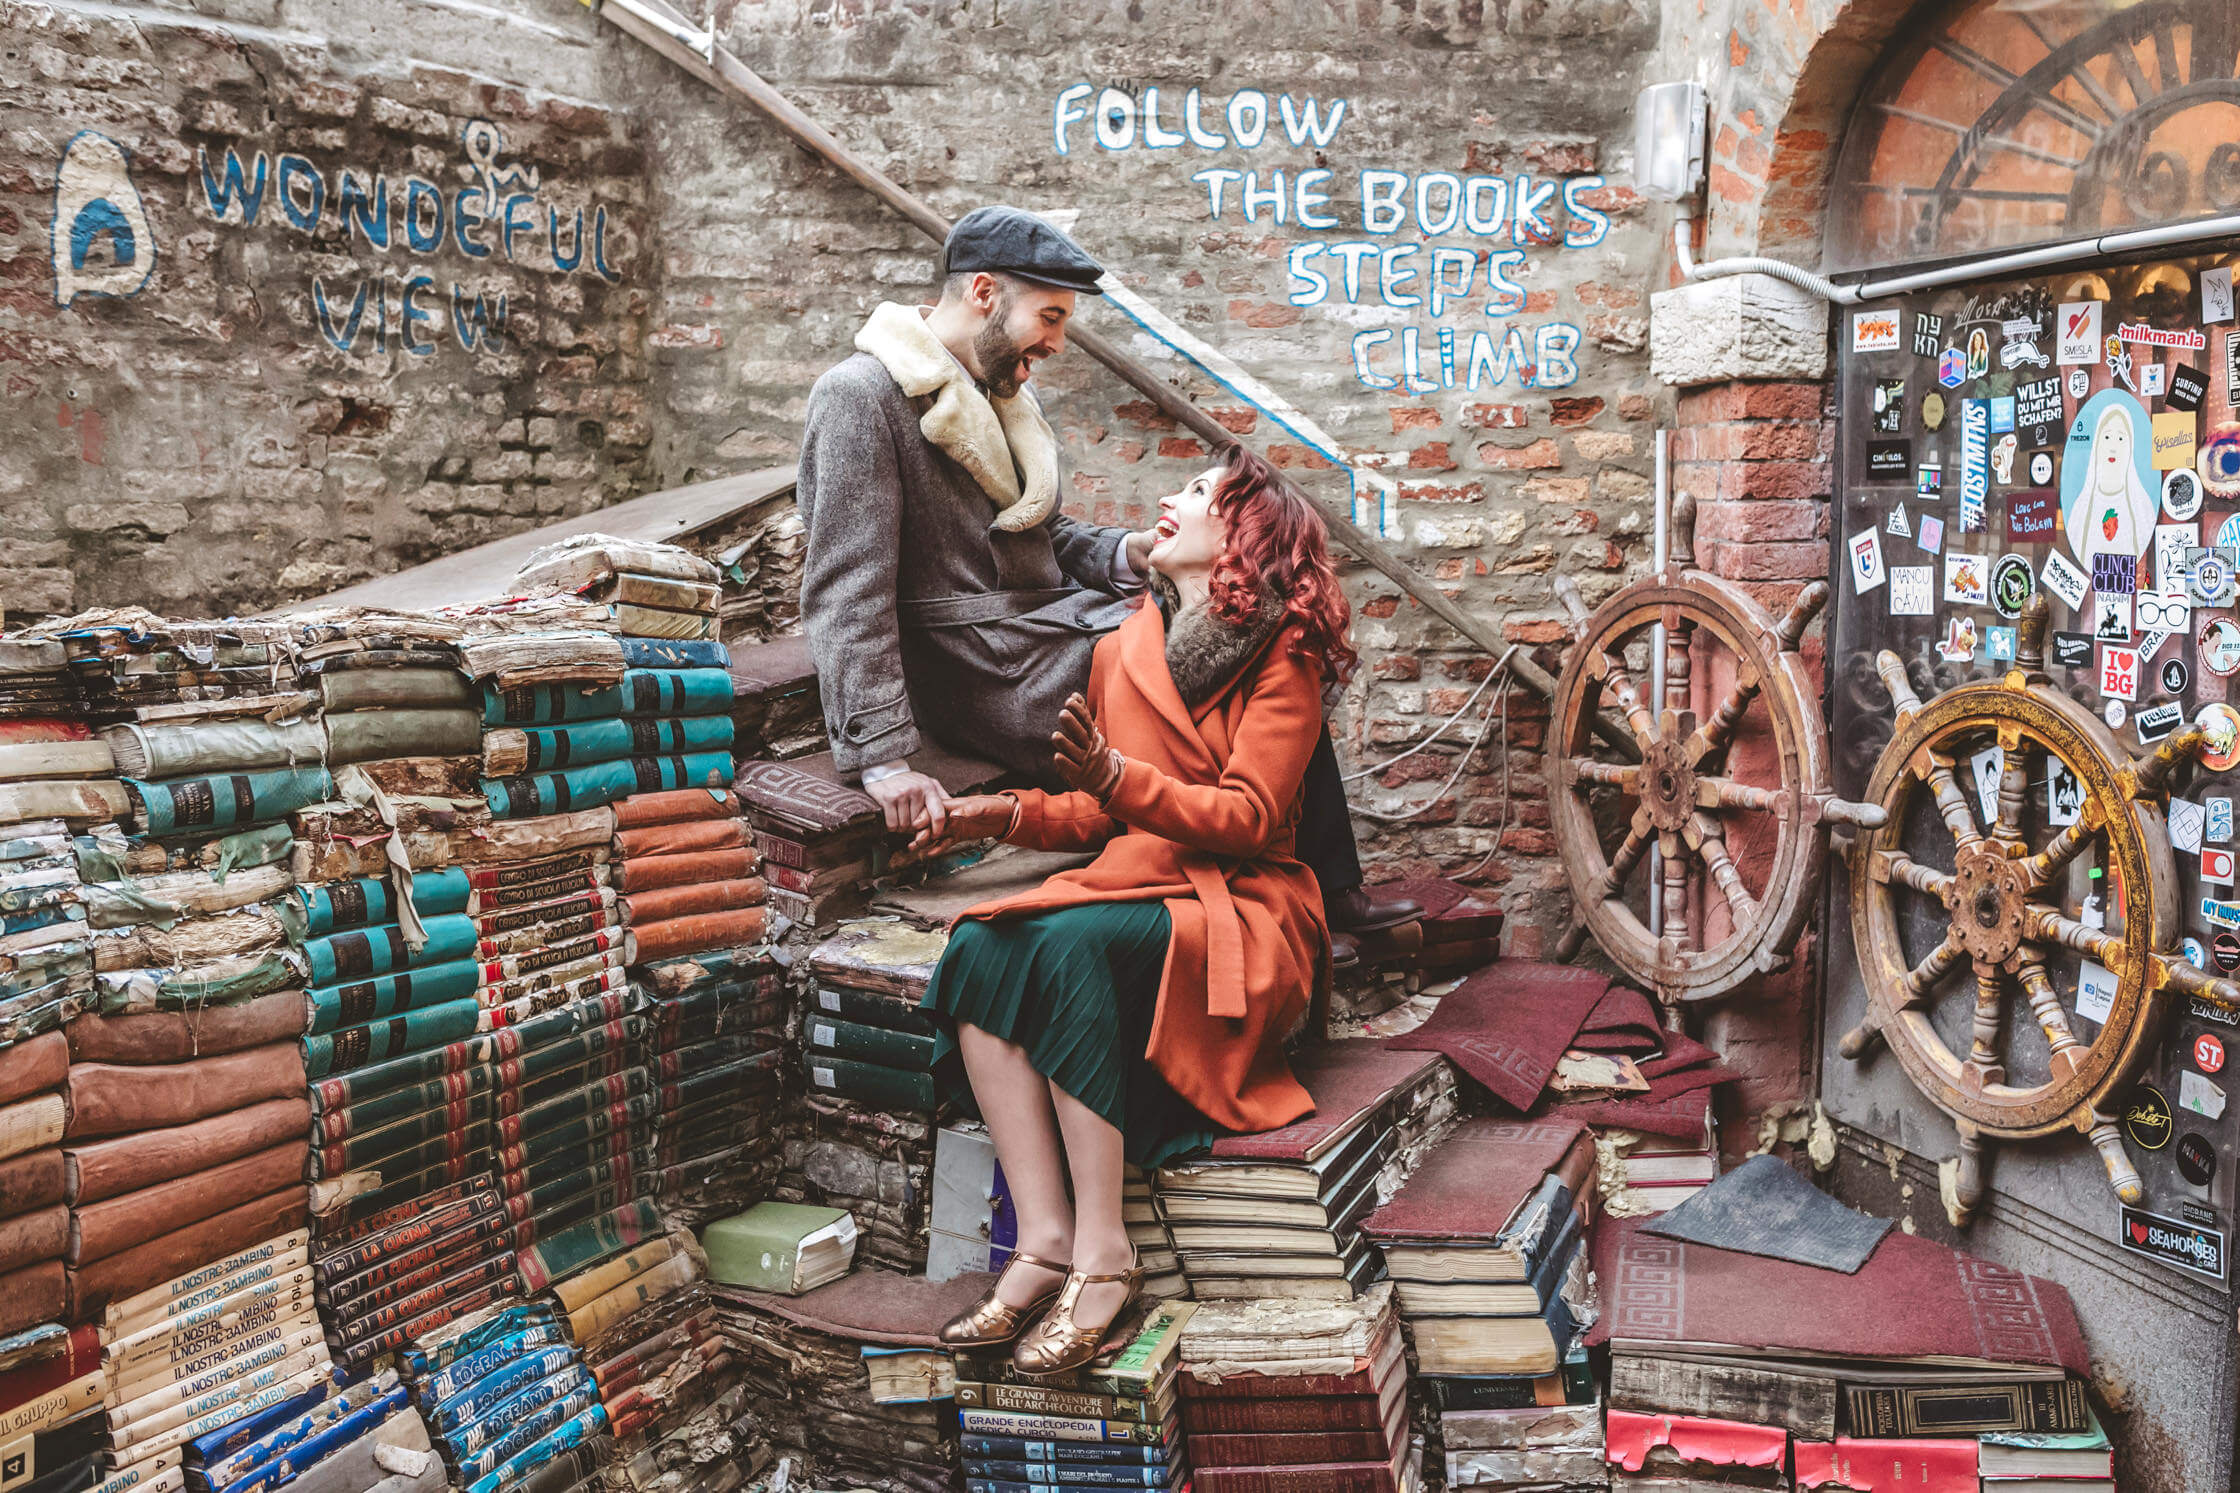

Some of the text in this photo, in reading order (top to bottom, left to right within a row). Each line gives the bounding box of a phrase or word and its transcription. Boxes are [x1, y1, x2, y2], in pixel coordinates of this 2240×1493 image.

[1054, 82, 1346, 155] FOLLOW
[1192, 168, 1611, 248] THE BOOKS
[1288, 240, 1526, 318] STEPS
[312, 274, 509, 356] VIEW
[2120, 325, 2204, 348] milkman.la
[1352, 321, 1582, 396] CLIMB
[2016, 377, 2060, 401] WILLST
[2017, 395, 2061, 415] DU MIT MIR
[2018, 407, 2063, 427] SCHAFEN?
[2070, 434, 2090, 442] TREZOR
[2092, 573, 2136, 594] CLUB
[2093, 553, 2136, 576] CLINCH
[2096, 593, 2130, 604] NAWM
[2107, 650, 2118, 671] I
[2103, 671, 2134, 696] BG
[2203, 899, 2240, 923] MY HOUS
[2197, 1041, 2221, 1068] ST.
[350, 1220, 369, 1239] LA
[372, 1201, 422, 1230] CUCINA
[2126, 1217, 2131, 1238] I
[2148, 1226, 2217, 1262] SEAHORSES
[361, 1243, 381, 1262] LA
[383, 1222, 432, 1251] CUCINA
[171, 1283, 183, 1296] IL
[225, 1245, 274, 1273] BAMBINO
[288, 1238, 297, 1248] 8
[368, 1267, 386, 1288] LA
[389, 1247, 437, 1277] CUCINA
[375, 1287, 393, 1305] LA
[396, 1265, 442, 1293] CUCINA
[2203, 1260, 2217, 1270] CAFE
[168, 1304, 178, 1317] IL
[222, 1265, 273, 1294] BAMBINO
[176, 1273, 304, 1332] IL NOSTR BINO 9
[377, 1308, 396, 1327] LA
[398, 1284, 446, 1315] CUCINA
[169, 1350, 181, 1363] IL
[225, 1311, 277, 1340] BAMBINO
[292, 1301, 302, 1312] 6
[172, 1335, 183, 1348] IL
[183, 1319, 224, 1343] NOSTR
[239, 1296, 278, 1321] MBINO
[291, 1286, 302, 1300] 10
[384, 1307, 453, 1349] LA CUCINA
[174, 1368, 186, 1380] IL
[230, 1327, 282, 1356] BAMBINO
[181, 1386, 192, 1399] IL
[236, 1344, 287, 1375] BAMBINO
[301, 1335, 311, 1346] 3
[0, 1394, 68, 1436] IL GRUPPO
[186, 1405, 197, 1418] IL
[186, 1425, 199, 1438] IL
[245, 1386, 287, 1412] BAMBIN
[491, 1387, 548, 1433] OCEANI
[996, 1387, 1006, 1398] LE
[1008, 1388, 1045, 1401] GRANDI
[1048, 1393, 1103, 1407] AVVENTURE
[501, 1411, 559, 1458] OCEANI
[969, 1416, 1096, 1432] GRANDE ENCICLOPEDIA
[1017, 1429, 1057, 1438] CURCIO
[98, 1459, 166, 1493] MBINO 4
[156, 1481, 168, 1491] 5
